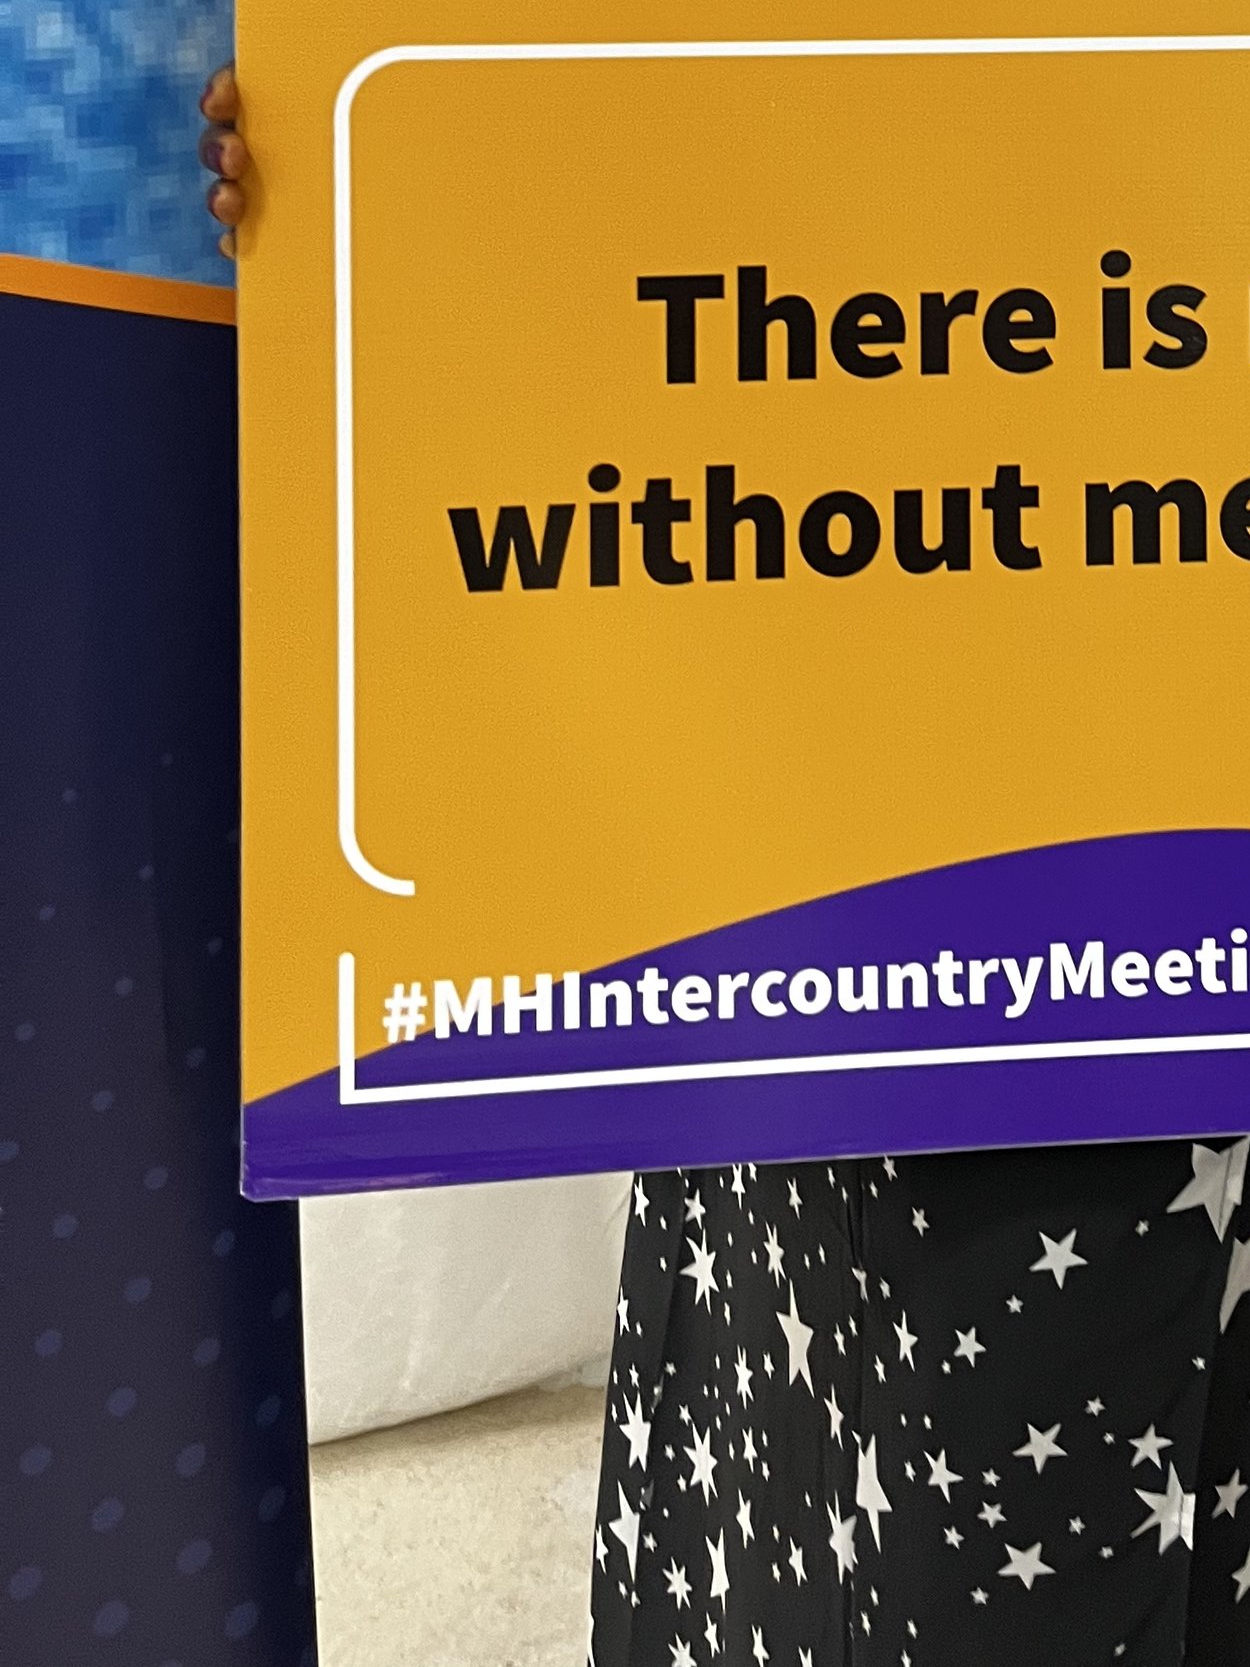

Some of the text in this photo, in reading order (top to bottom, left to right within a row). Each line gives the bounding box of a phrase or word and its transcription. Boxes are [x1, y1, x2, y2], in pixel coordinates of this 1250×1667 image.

[636, 264, 1057, 385] There
[1100, 249, 1208, 370] is
[447, 463, 1043, 593] without
